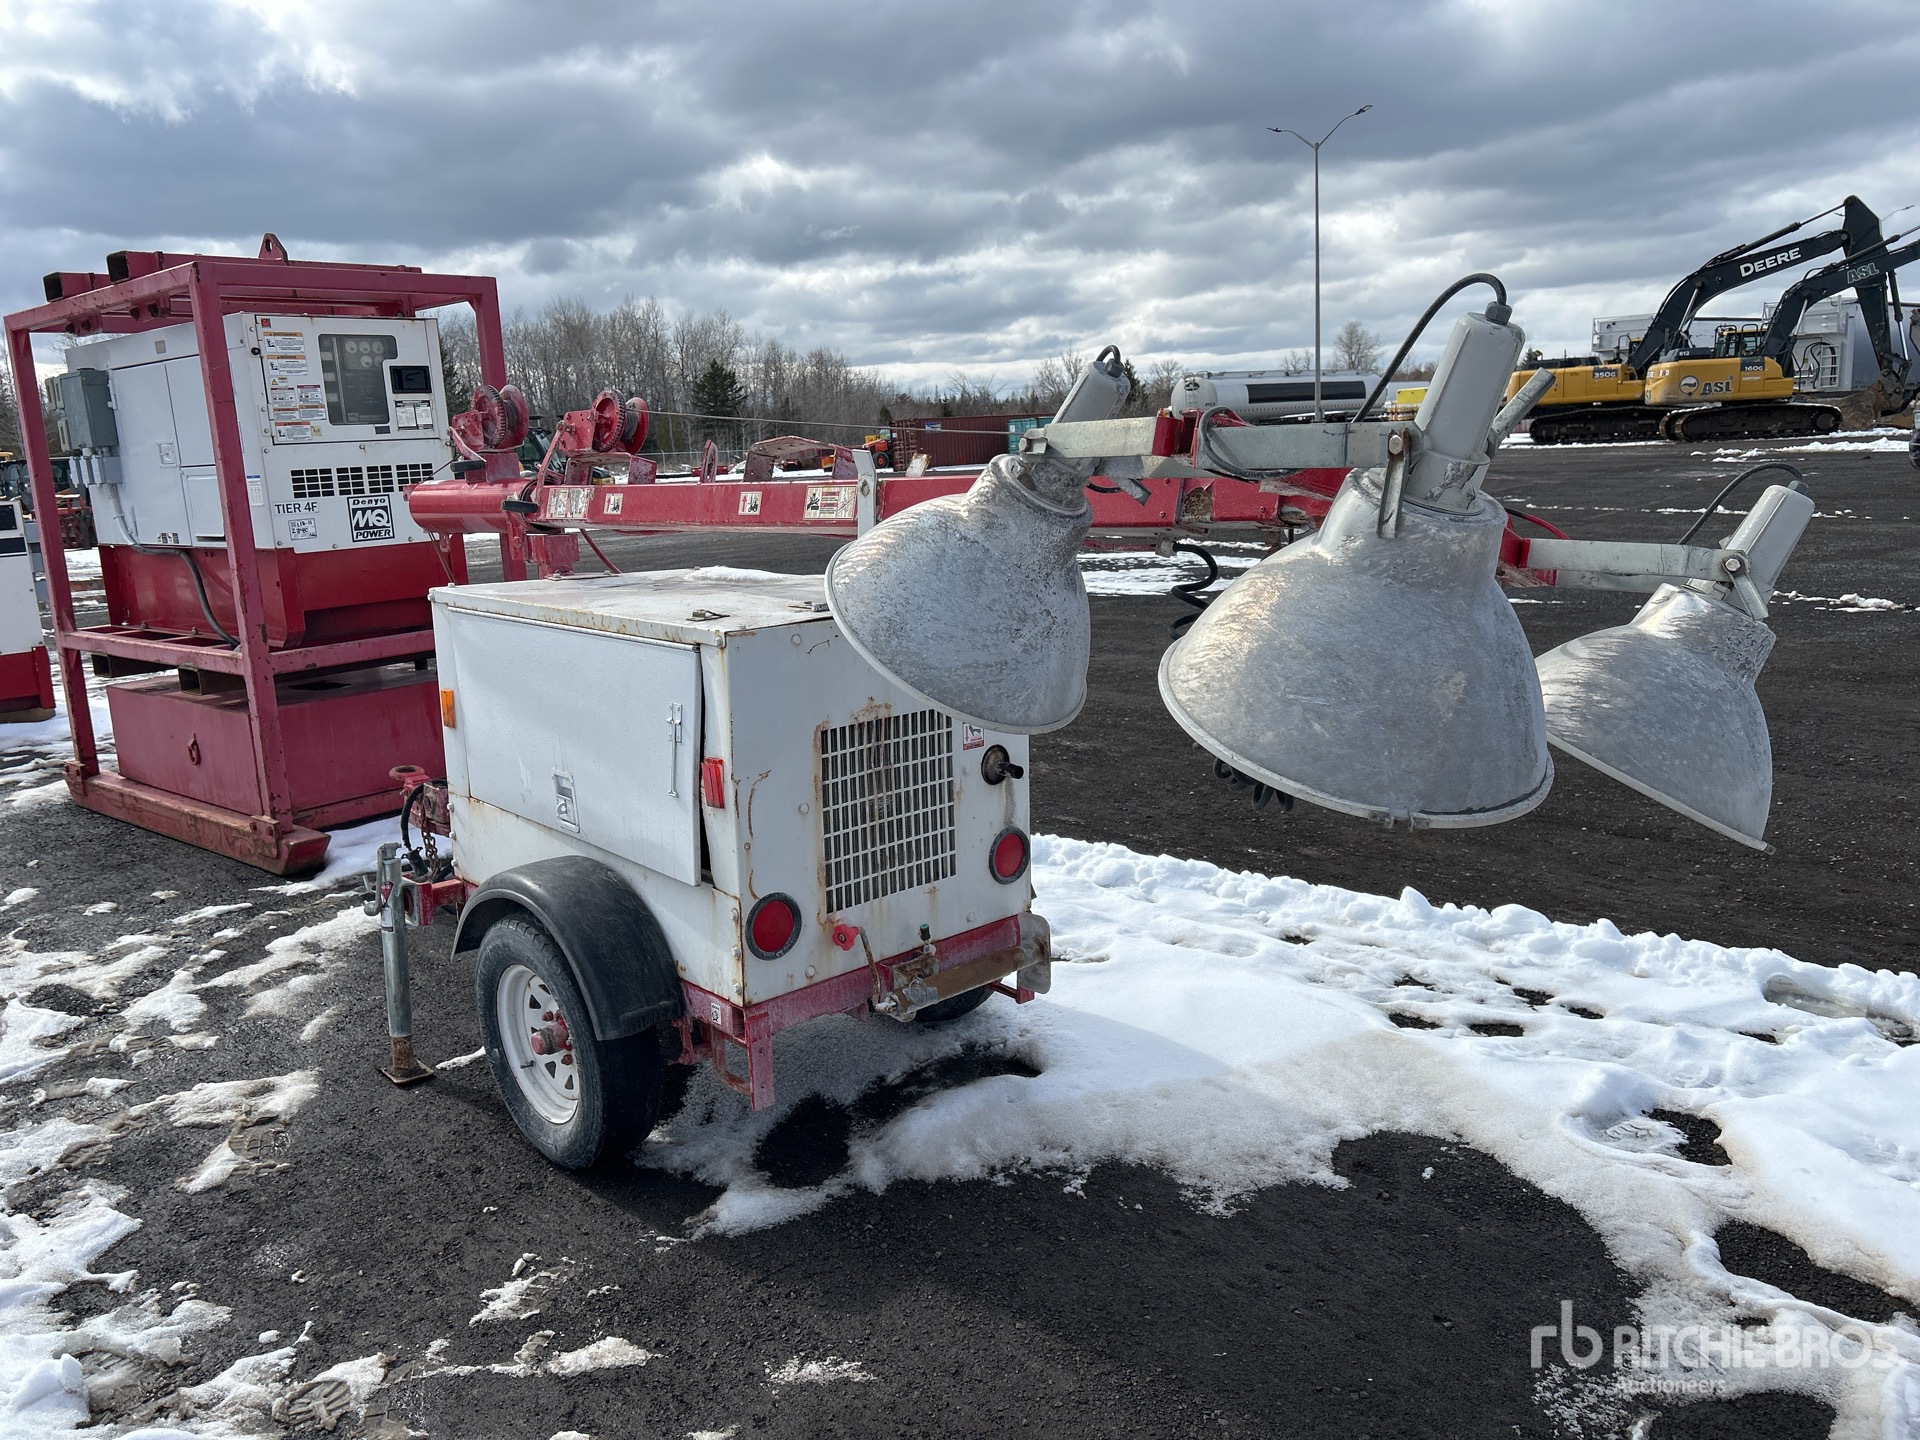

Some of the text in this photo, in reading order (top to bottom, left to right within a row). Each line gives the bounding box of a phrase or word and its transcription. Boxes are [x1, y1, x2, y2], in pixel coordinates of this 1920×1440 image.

[1739, 247, 1802, 278] DEERE
[1846, 262, 1880, 284] ASL
[1701, 380, 1733, 395] ASL
[275, 501, 318, 515] TIER 4F
[352, 497, 386, 506] Denyo
[352, 508, 391, 529] MQ
[355, 529, 391, 540] POWER
